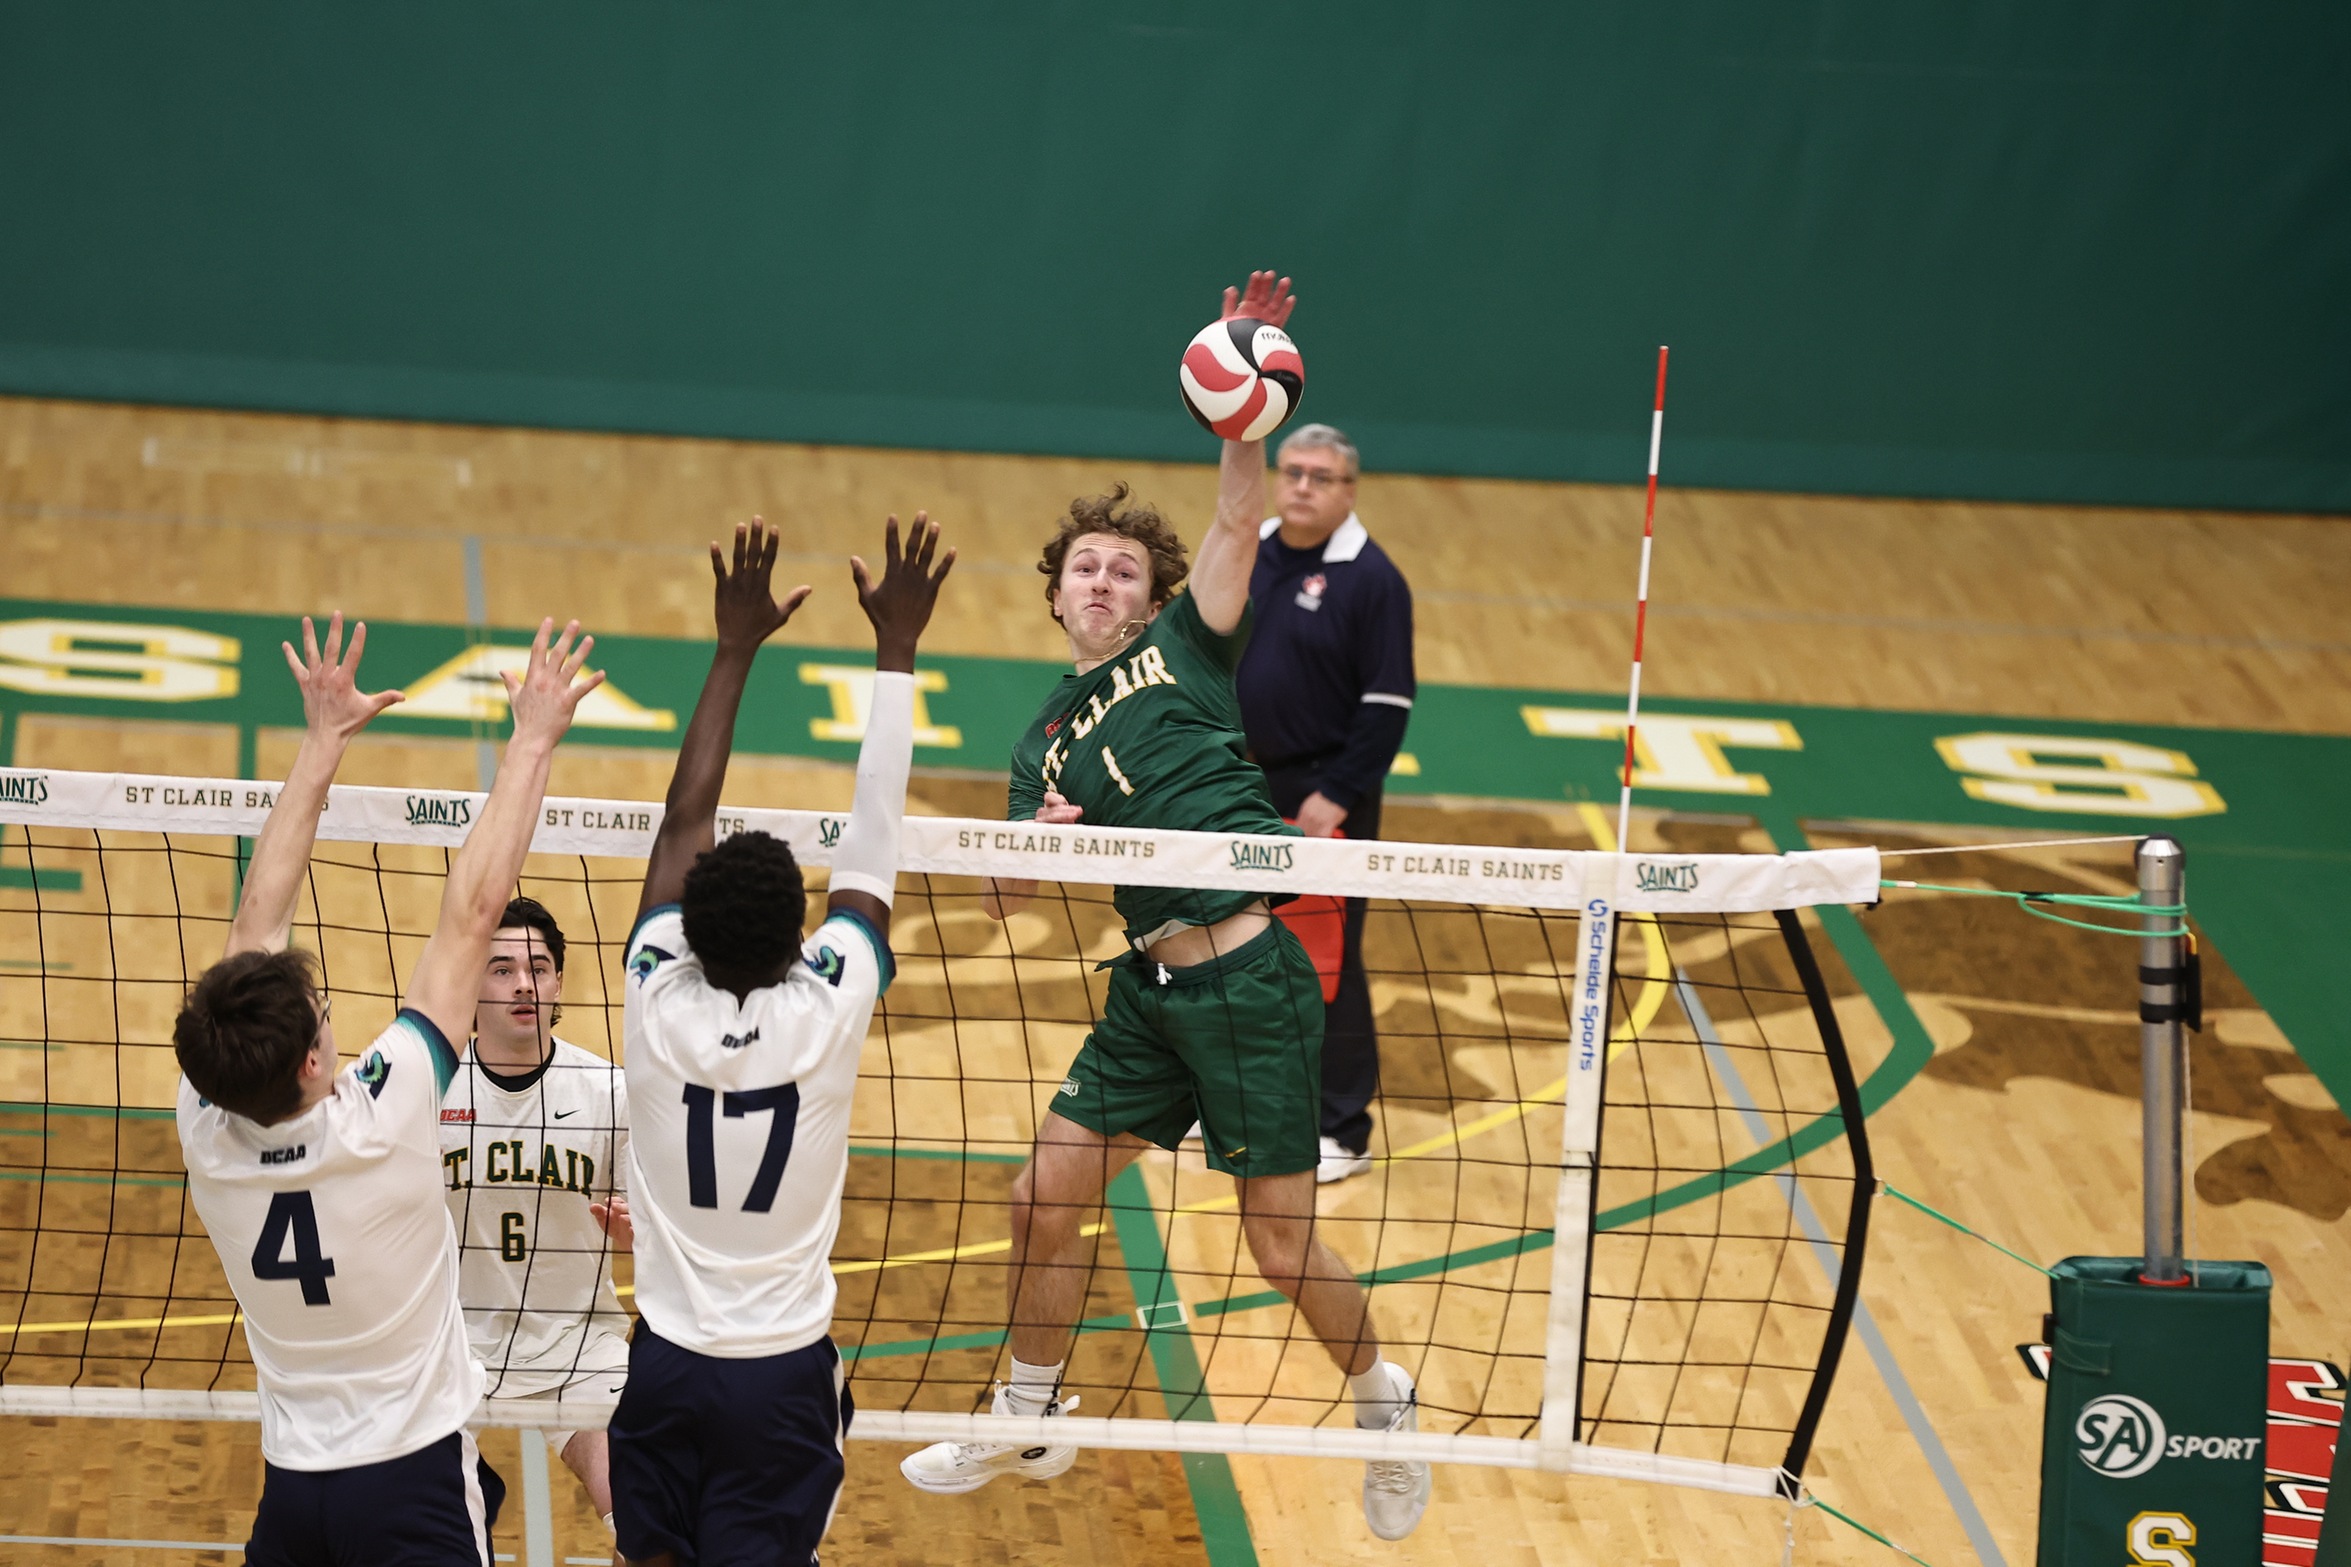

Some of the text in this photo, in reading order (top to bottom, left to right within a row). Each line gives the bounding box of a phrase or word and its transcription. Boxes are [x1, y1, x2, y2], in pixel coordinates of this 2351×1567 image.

[1102, 745, 1135, 796] 1
[126, 786, 154, 803] ST
[164, 788, 233, 807] CLAIR
[404, 795, 471, 827] SAINTS
[546, 809, 651, 831] ST CLAIR
[958, 831, 1155, 858] ST CLAIR SAINTS
[1229, 840, 1293, 871] SAINTS
[1367, 854, 1564, 881] ST CLAIR SAINTS
[1635, 863, 1699, 892] SAINTS
[1579, 921, 1607, 1071] Schelde Sports
[682, 1081, 800, 1213] 17
[251, 1190, 336, 1307] 4
[501, 1212, 526, 1262] 6
[2165, 1435, 2261, 1461] SPORT
